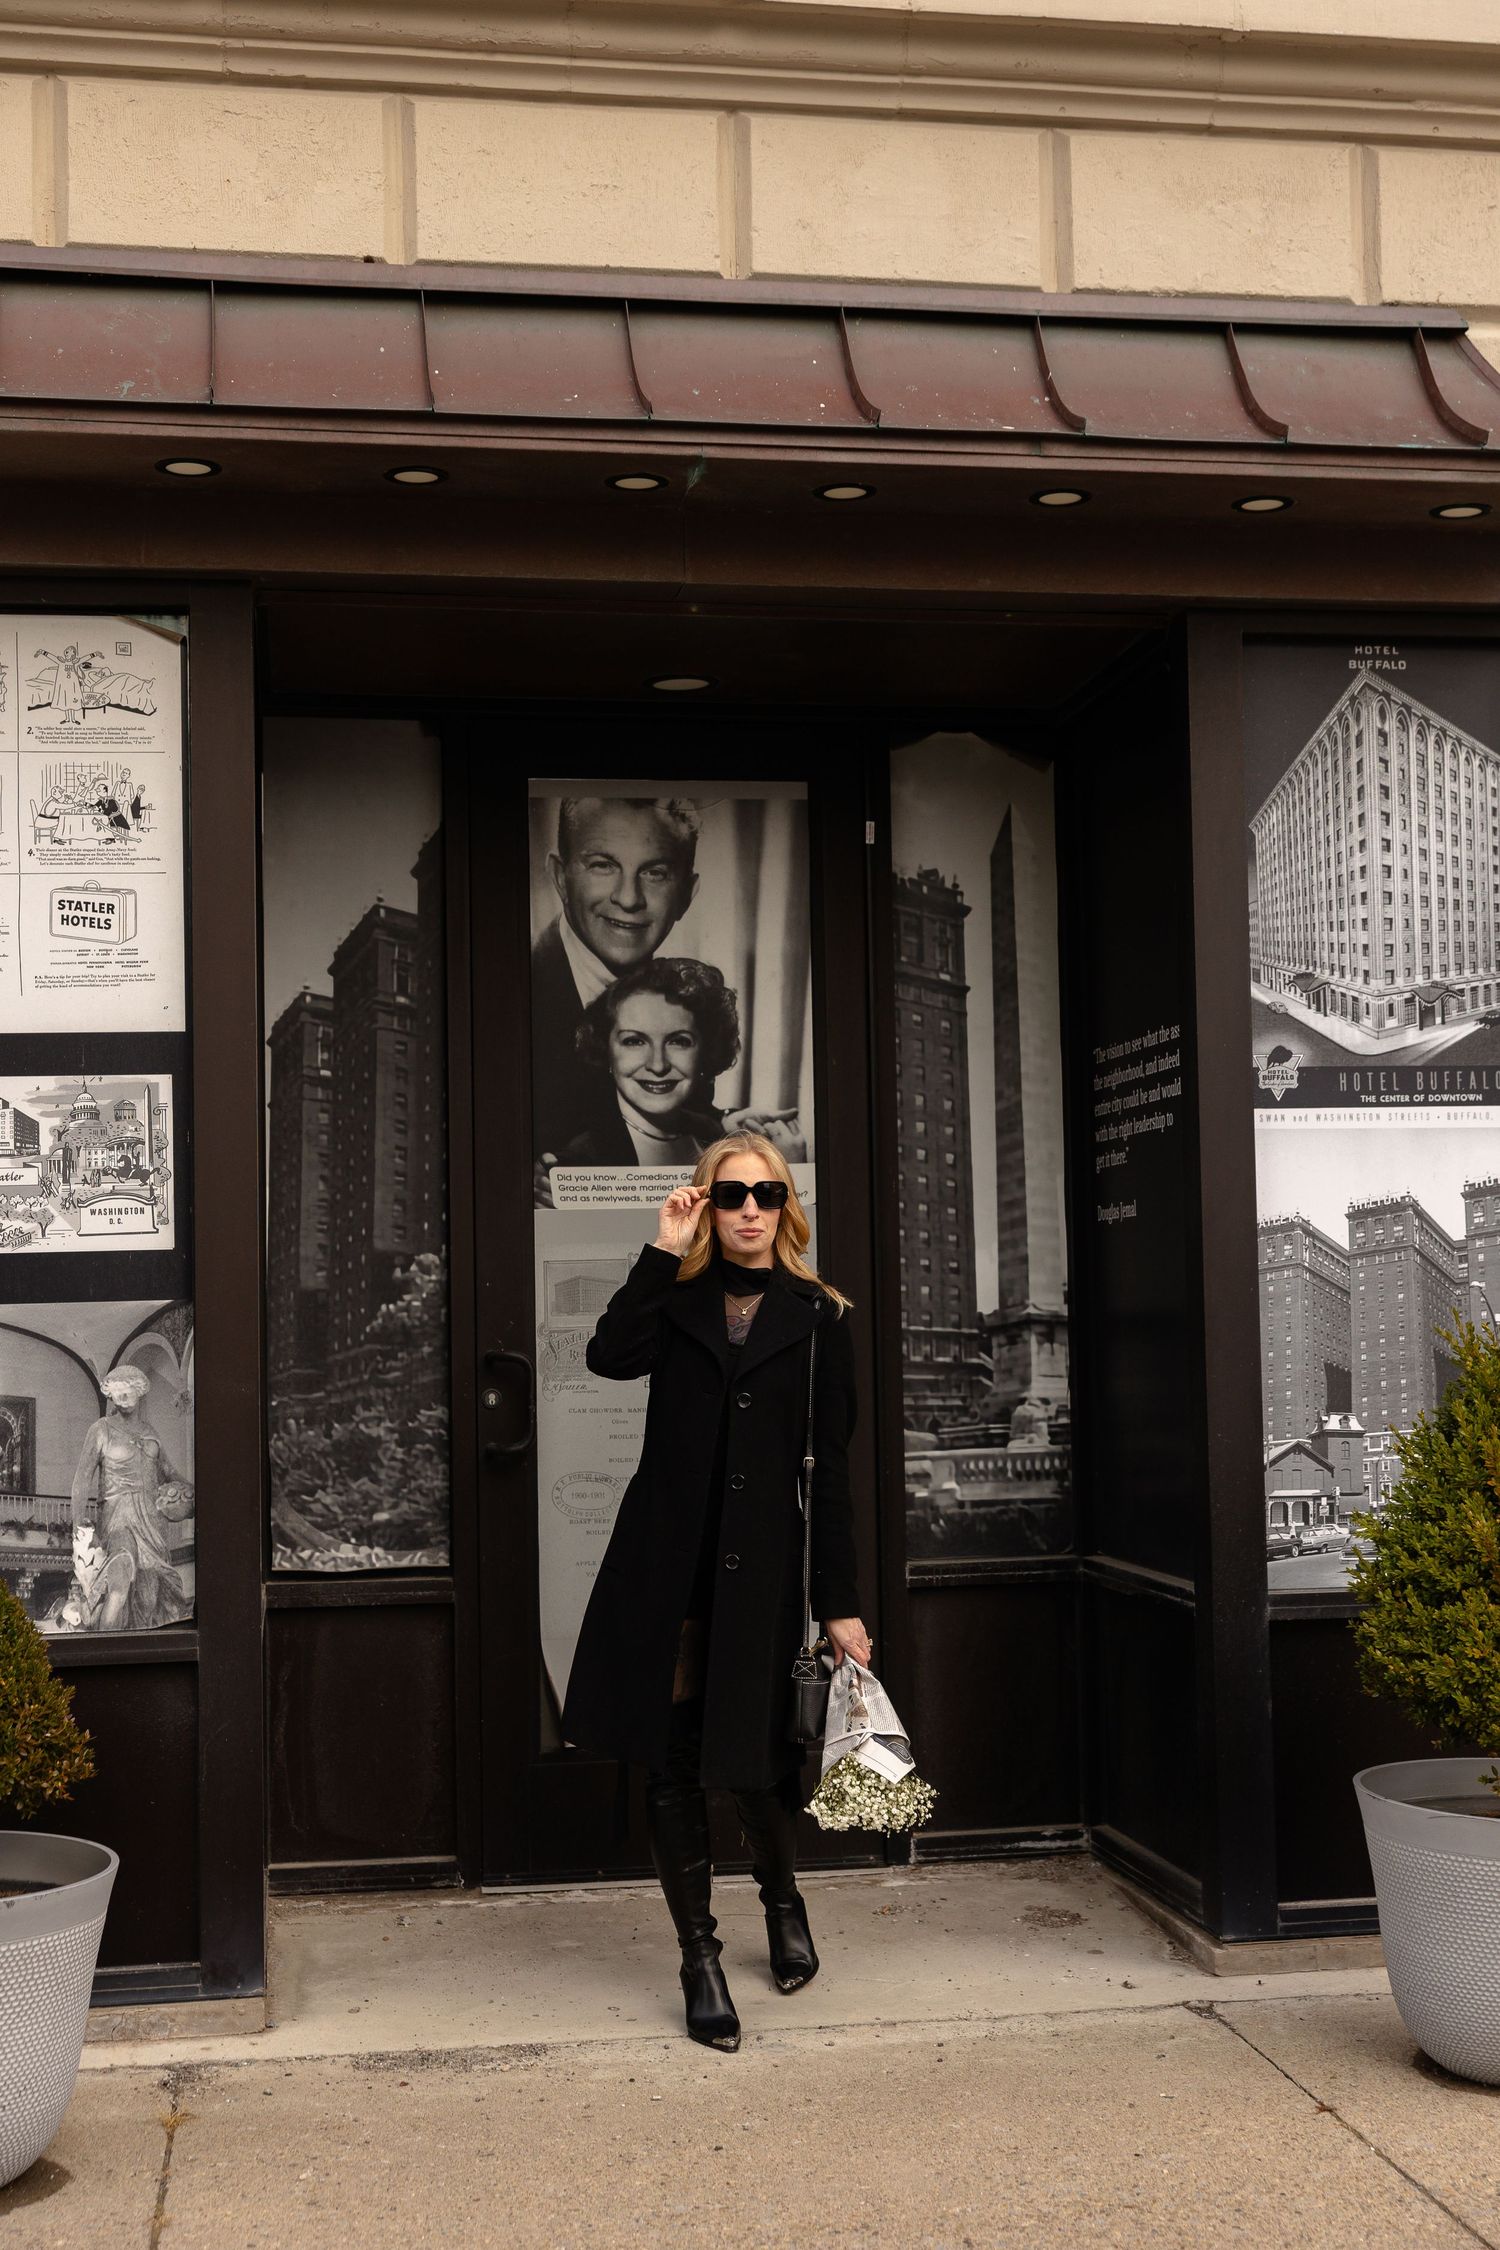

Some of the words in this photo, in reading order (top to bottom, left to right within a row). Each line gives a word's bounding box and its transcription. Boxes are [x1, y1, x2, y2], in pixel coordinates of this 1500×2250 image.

[1355, 646, 1399, 655] HOTEL
[1348, 660, 1406, 670] BUFFALO
[57, 899, 116, 915] STATLER
[60, 914, 112, 930] HOTELS
[1132, 1038, 1142, 1053] see
[1142, 1030, 1158, 1048] what
[1159, 1025, 1170, 1043] the
[1145, 1056, 1157, 1076] and
[1158, 1048, 1180, 1072] indeed
[1339, 1072, 1399, 1091] HOTEL
[1111, 1096, 1122, 1115] city
[1123, 1089, 1139, 1110] could
[1140, 1088, 1148, 1105] be
[1148, 1082, 1160, 1103] and
[1161, 1077, 1182, 1098] would
[1413, 1094, 1425, 1102] OF
[1428, 1094, 1483, 1102] DOWNTOWN
[1259, 1114, 1286, 1122] SWAN
[1292, 1114, 1308, 1122] and
[1316, 1113, 1381, 1122] WASHINGTON
[1388, 1112, 1430, 1121] STREETS
[1108, 1122, 1118, 1141] the
[1119, 1118, 1133, 1141] right
[1133, 1112, 1166, 1135] leadership
[1166, 1112, 1174, 1126] to
[558, 1184, 588, 1192] Gracie
[590, 1184, 613, 1192] Allen
[639, 1184, 674, 1192] married
[592, 1194, 643, 1204] newlyweds,
[1354, 1194, 1401, 1210] HILTON
[90, 1207, 145, 1216] WASHINGTON
[1097, 1202, 1119, 1224] Douglas
[1120, 1199, 1137, 1222] Jemal
